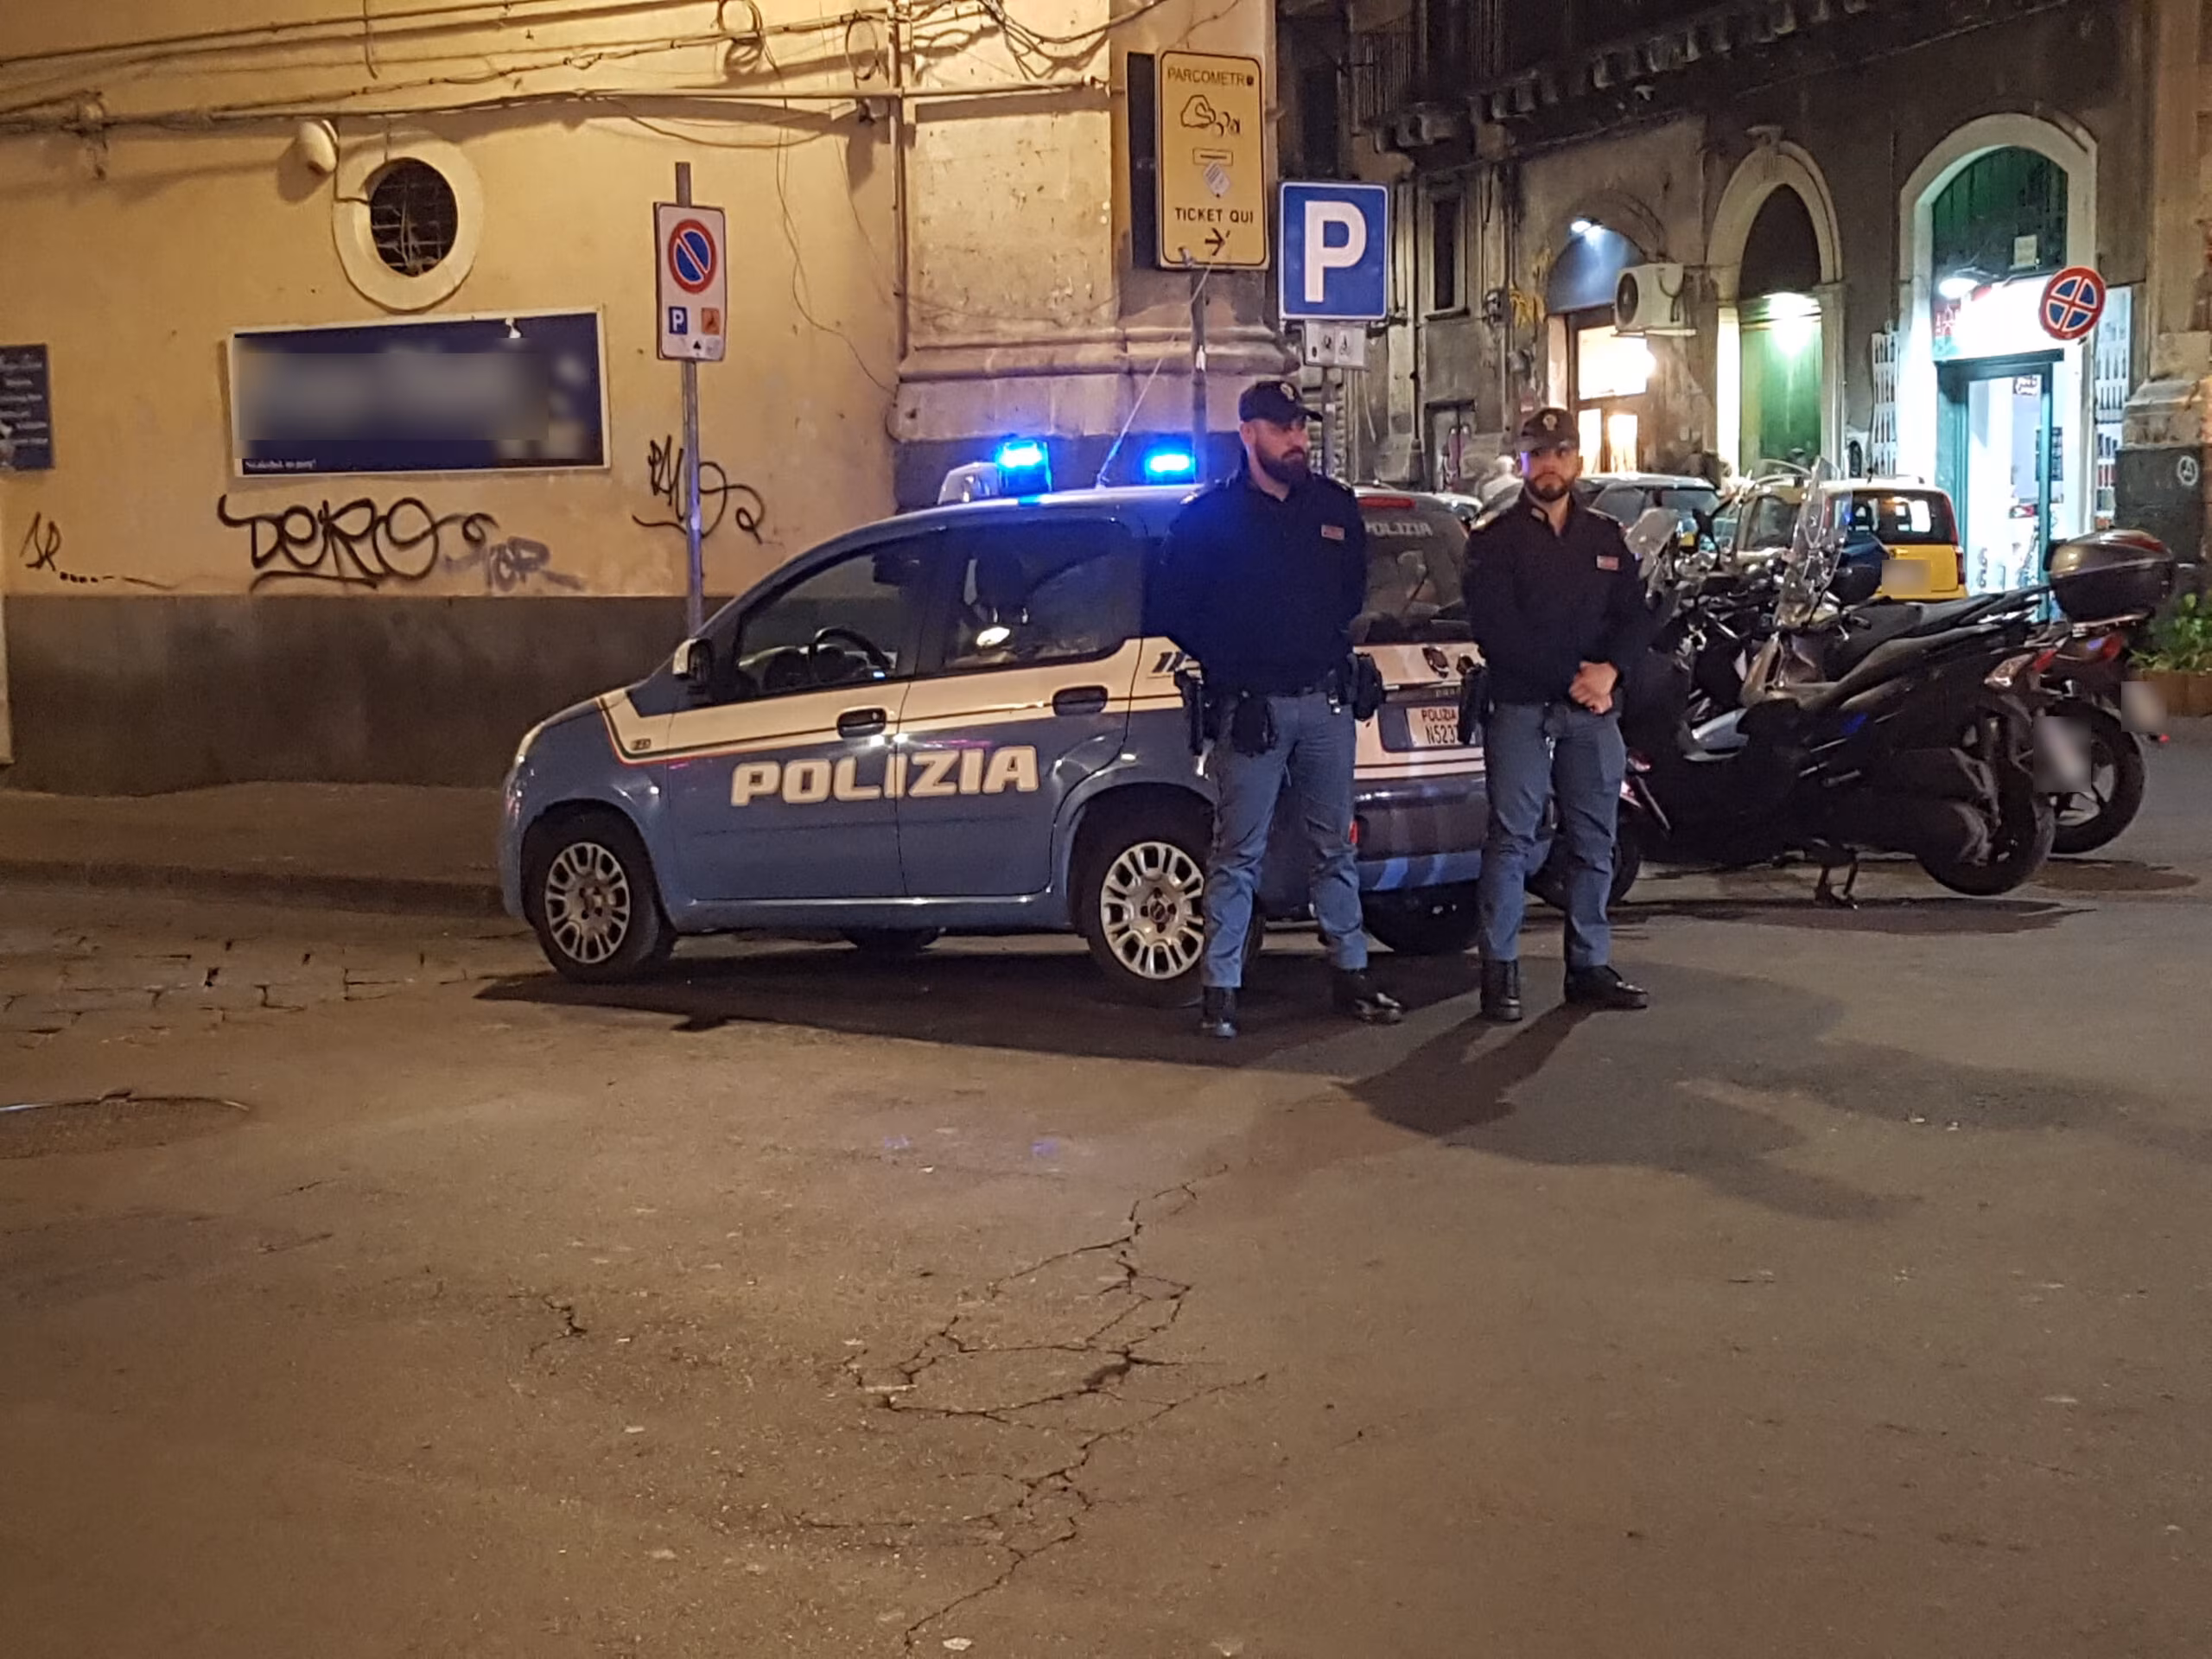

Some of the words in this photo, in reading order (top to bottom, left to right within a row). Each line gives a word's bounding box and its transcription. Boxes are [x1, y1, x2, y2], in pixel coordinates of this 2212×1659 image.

[1167, 67, 1255, 86] PARCOMETRO
[1175, 207, 1223, 223] TICKET
[1230, 209, 1254, 224] QUI
[1305, 200, 1368, 303] P
[672, 309, 684, 332] P
[1364, 520, 1433, 537] POLIZIA
[1421, 709, 1456, 723] POLIZIA
[731, 745, 1039, 807] POLIZIA
